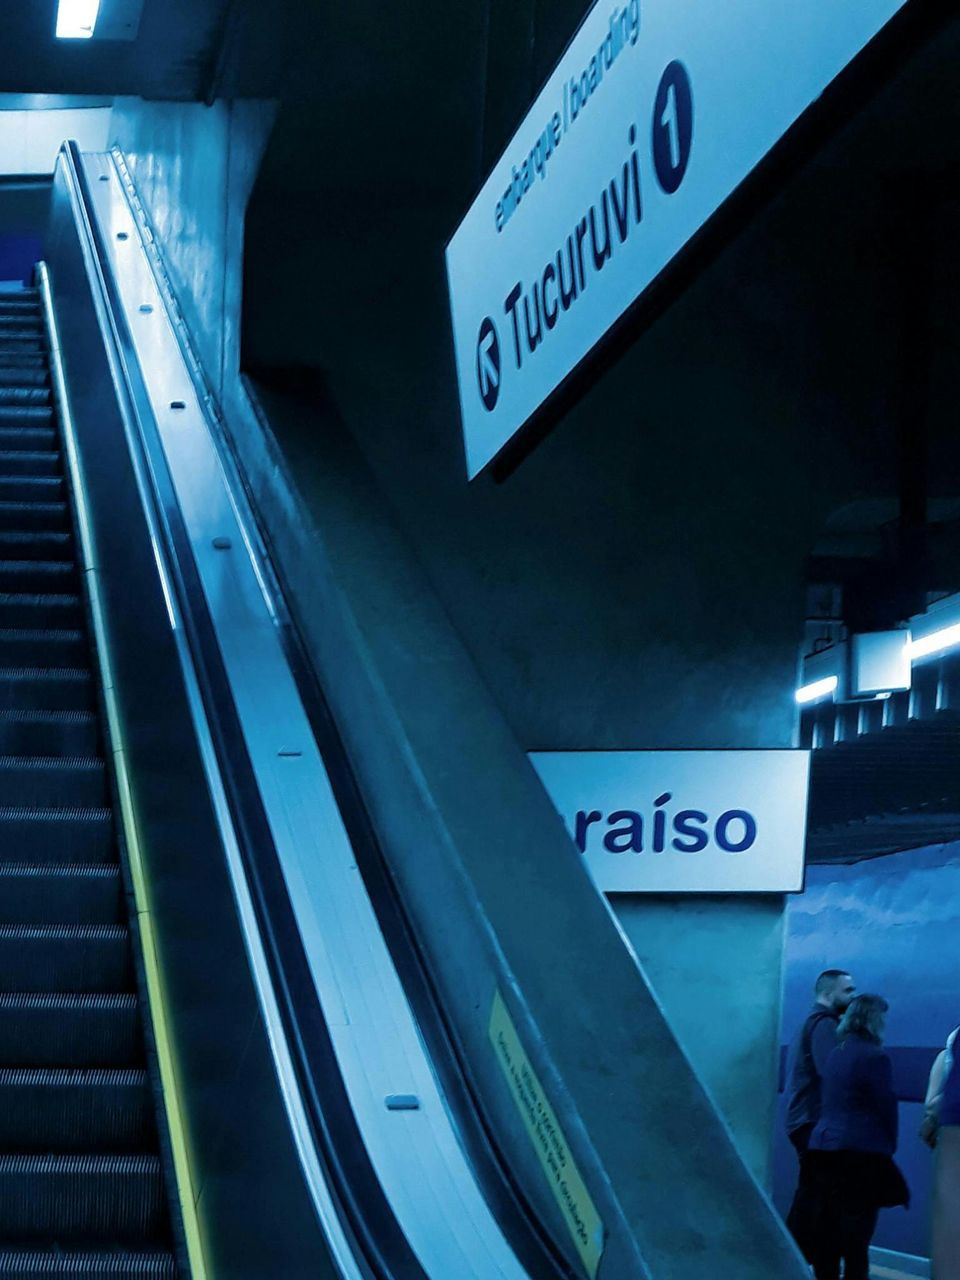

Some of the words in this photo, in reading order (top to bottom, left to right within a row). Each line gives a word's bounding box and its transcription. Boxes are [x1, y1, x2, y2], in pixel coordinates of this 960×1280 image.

[495, 112, 561, 233] embarque
[570, 0, 640, 123] boarding
[503, 121, 643, 370] Tucuruvi
[577, 792, 757, 853] raíso
